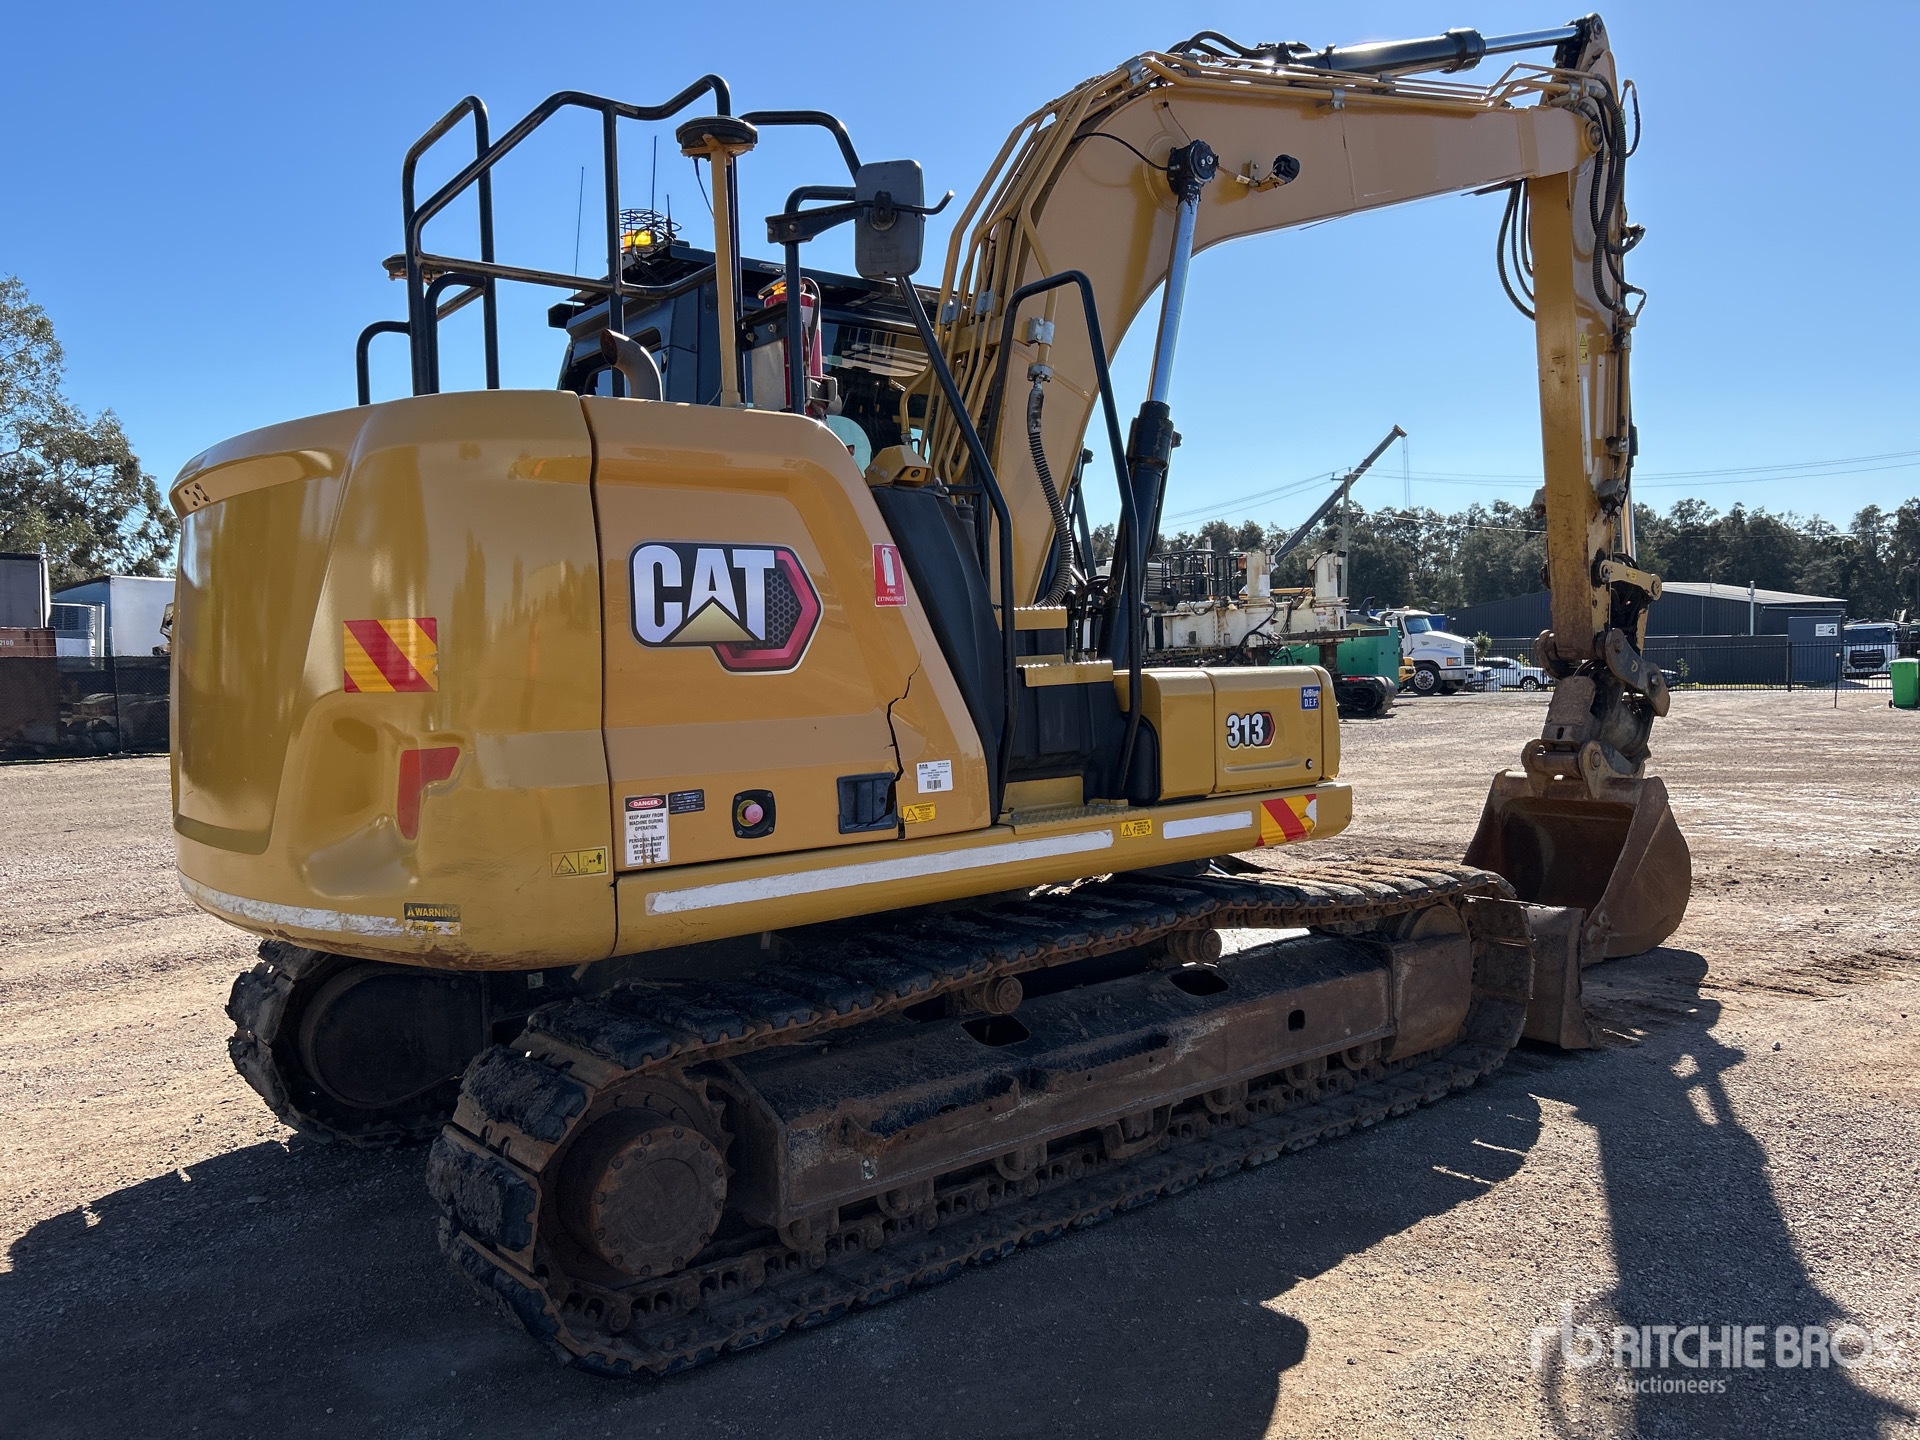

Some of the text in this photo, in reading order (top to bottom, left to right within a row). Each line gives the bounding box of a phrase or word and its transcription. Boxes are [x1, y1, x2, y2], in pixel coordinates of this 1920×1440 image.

[633, 544, 775, 643] CAT
[1828, 627, 1836, 635] 4
[1227, 713, 1264, 747] 313
[633, 799, 658, 807] DANGER
[415, 907, 459, 918] WARNING
